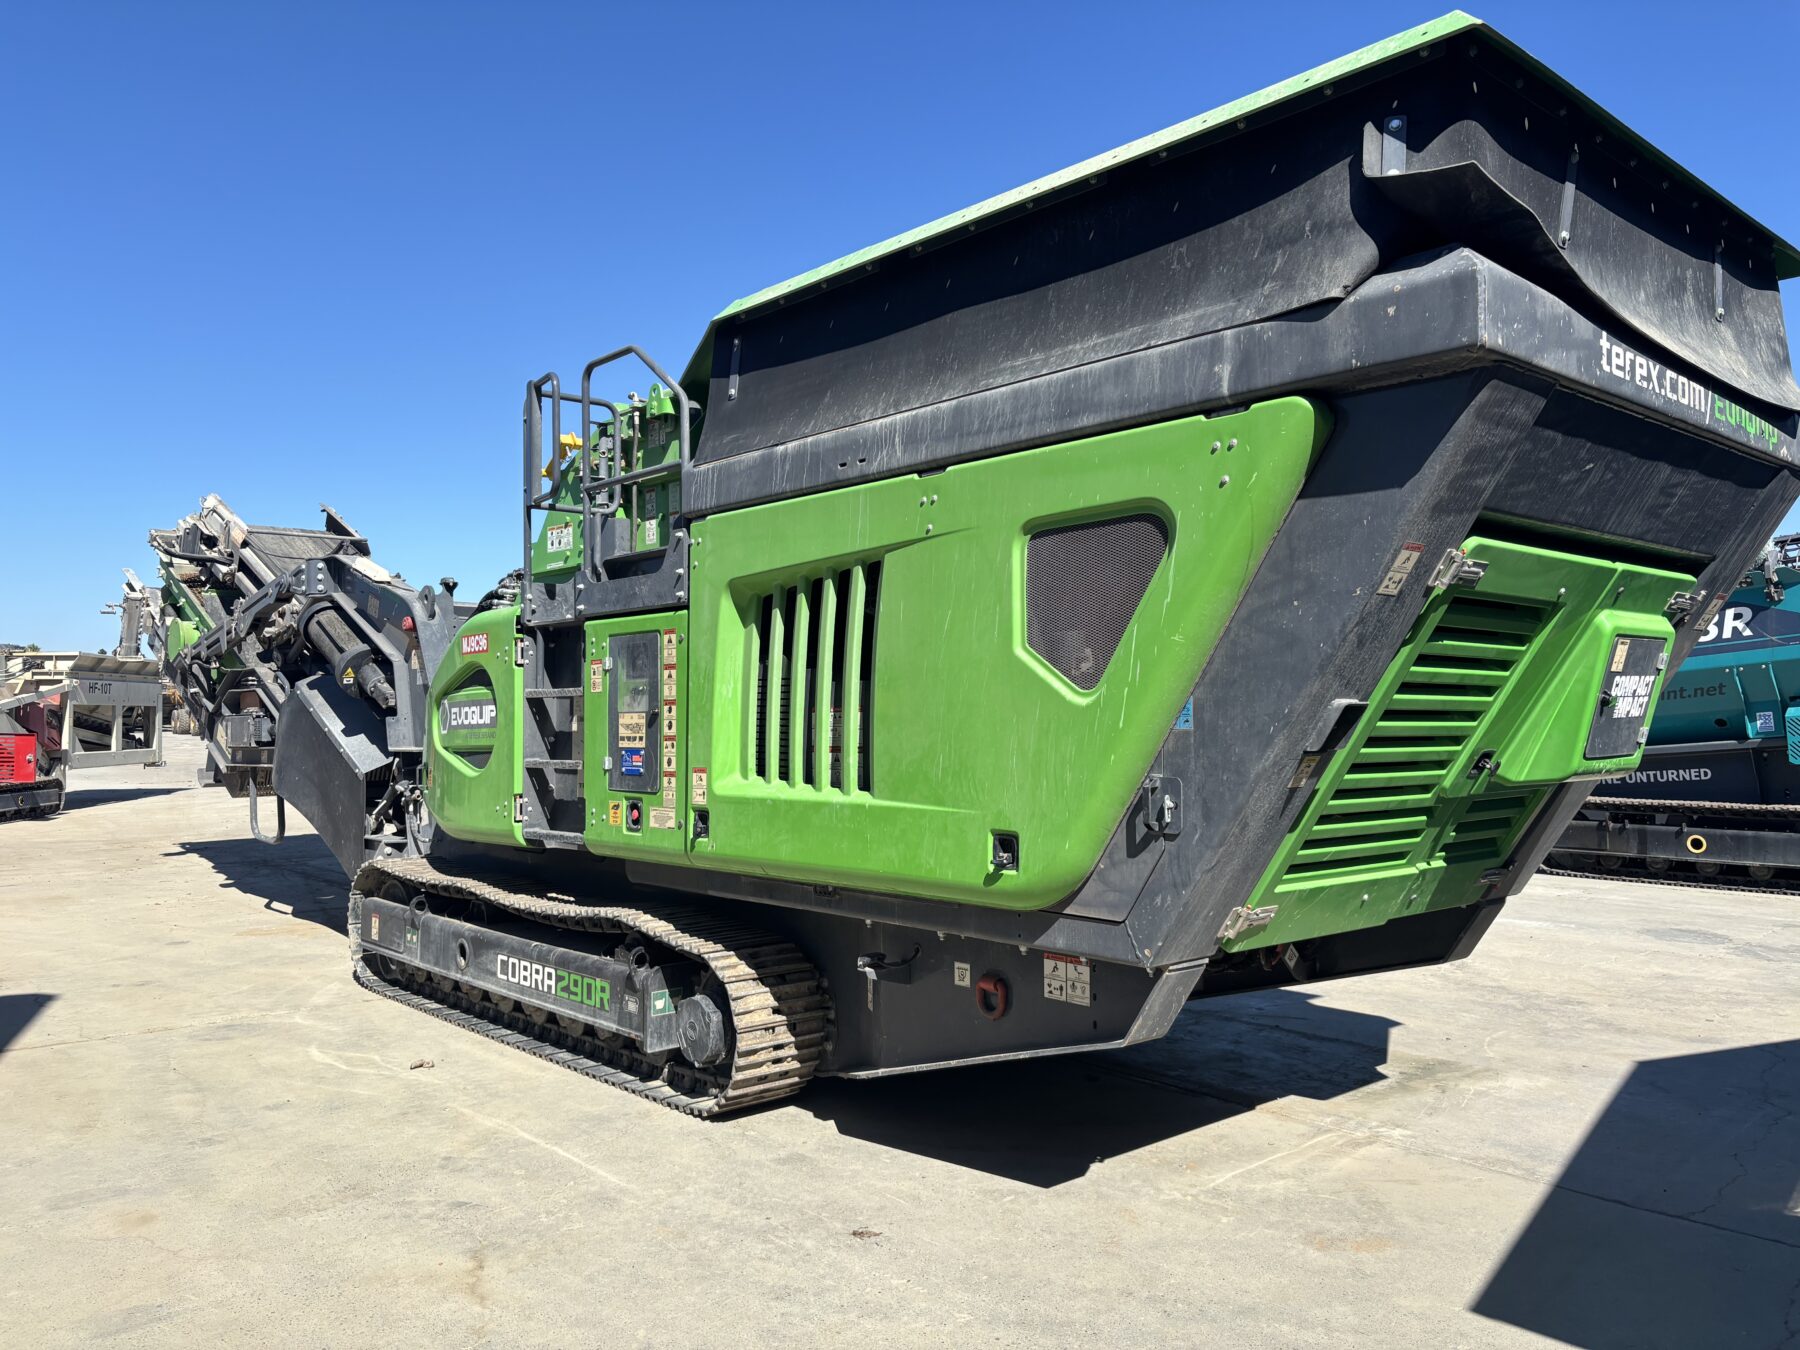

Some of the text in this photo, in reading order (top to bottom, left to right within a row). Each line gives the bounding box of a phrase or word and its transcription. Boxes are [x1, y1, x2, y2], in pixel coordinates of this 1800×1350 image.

[462, 634, 488, 654] MJ9C96
[88, 681, 113, 695] HF-10T
[1611, 675, 1656, 697] COMPACT
[451, 705, 497, 726] EVOQUIP
[1625, 768, 1712, 784] UNTURNED
